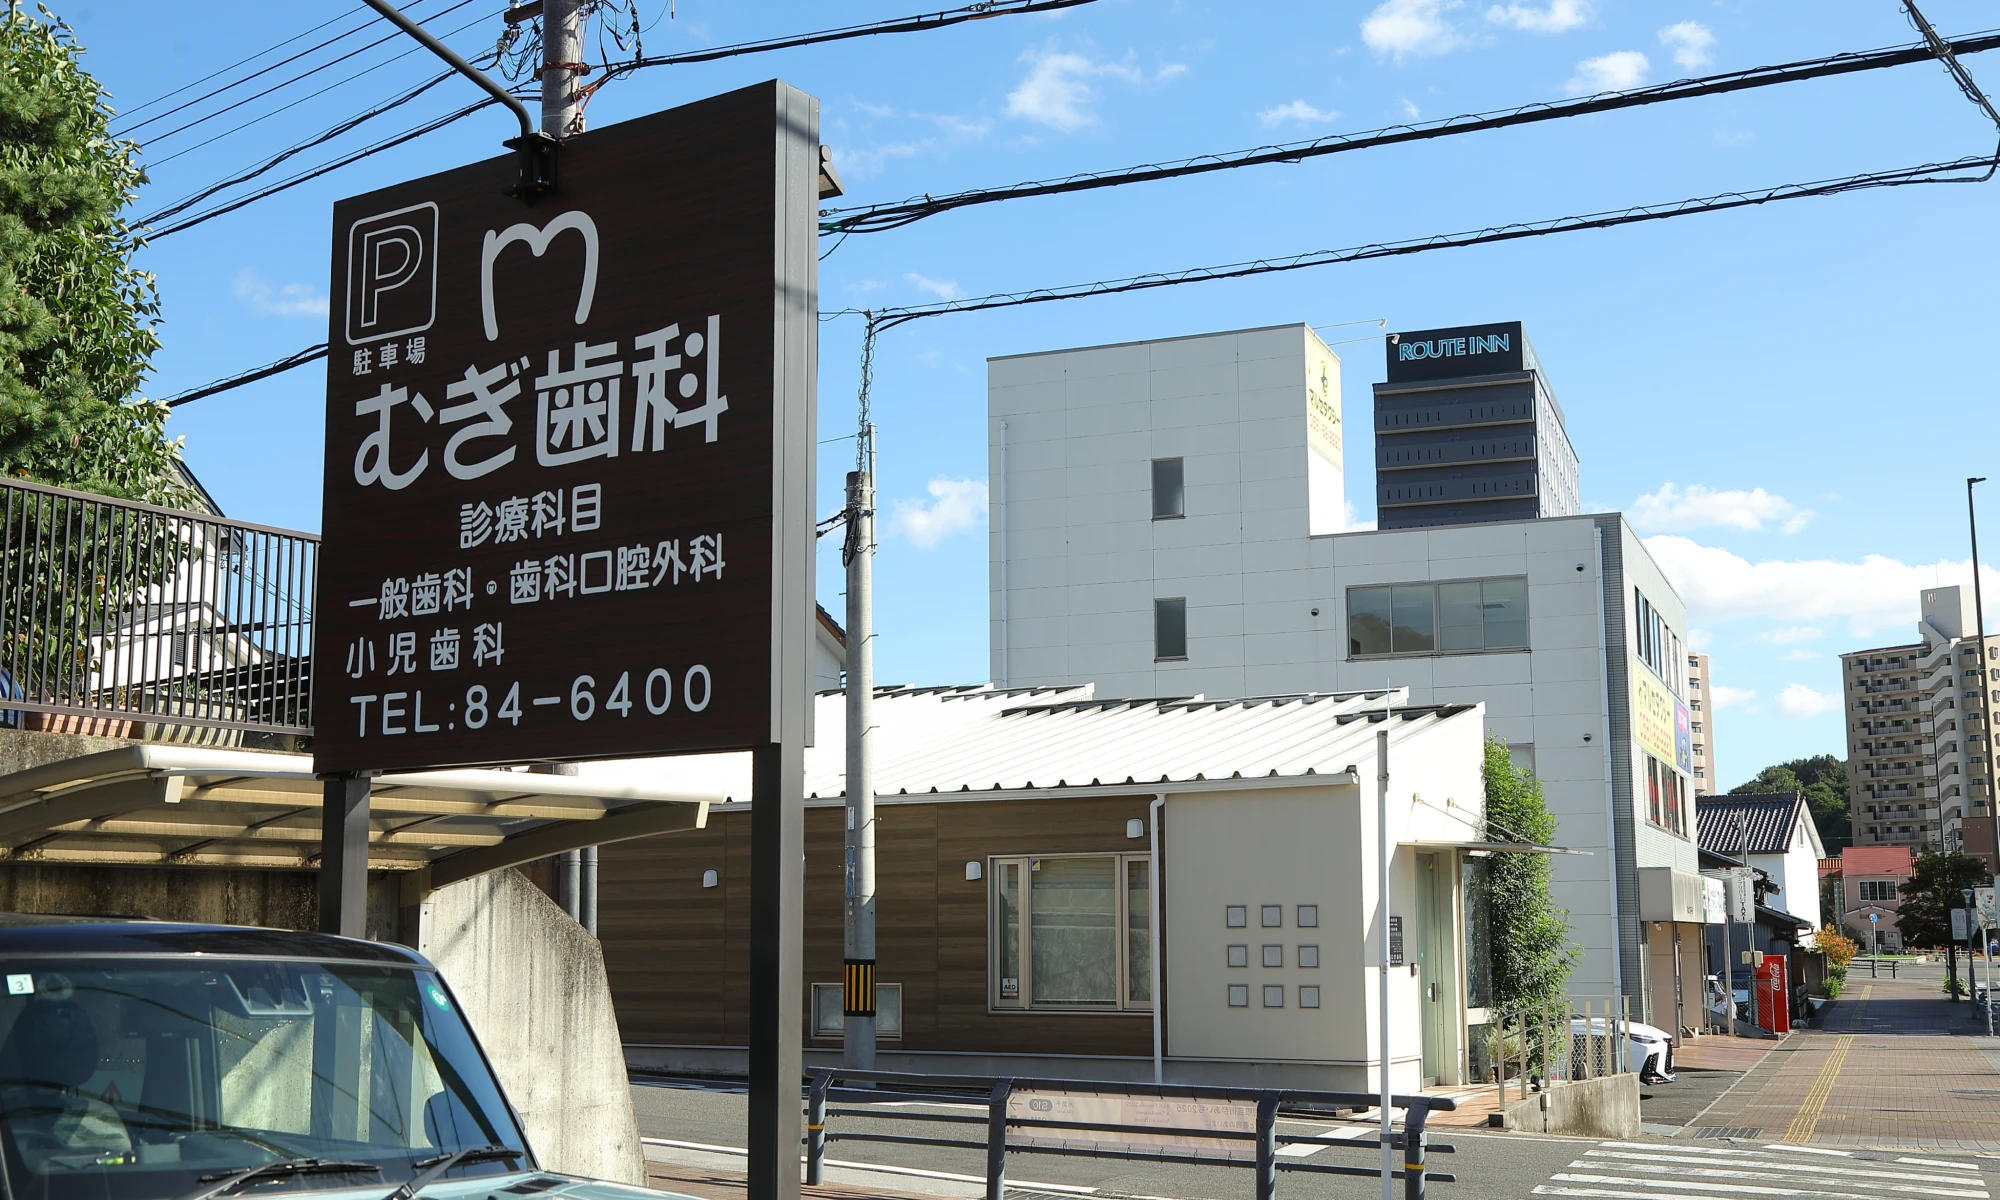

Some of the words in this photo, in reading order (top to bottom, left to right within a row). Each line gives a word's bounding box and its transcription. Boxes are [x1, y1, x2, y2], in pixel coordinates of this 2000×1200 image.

[360, 225, 423, 328] P
[352, 336, 427, 376] 駐車場
[1399, 337, 1466, 361] ROUTE
[1469, 333, 1510, 355] INN
[354, 314, 729, 490] むぎ歯科
[460, 483, 602, 549] 診療科目
[346, 621, 505, 679] 小児歯科
[350, 664, 712, 738] TEL:84-6400
[1768, 961, 1780, 991] Coca-Cola
